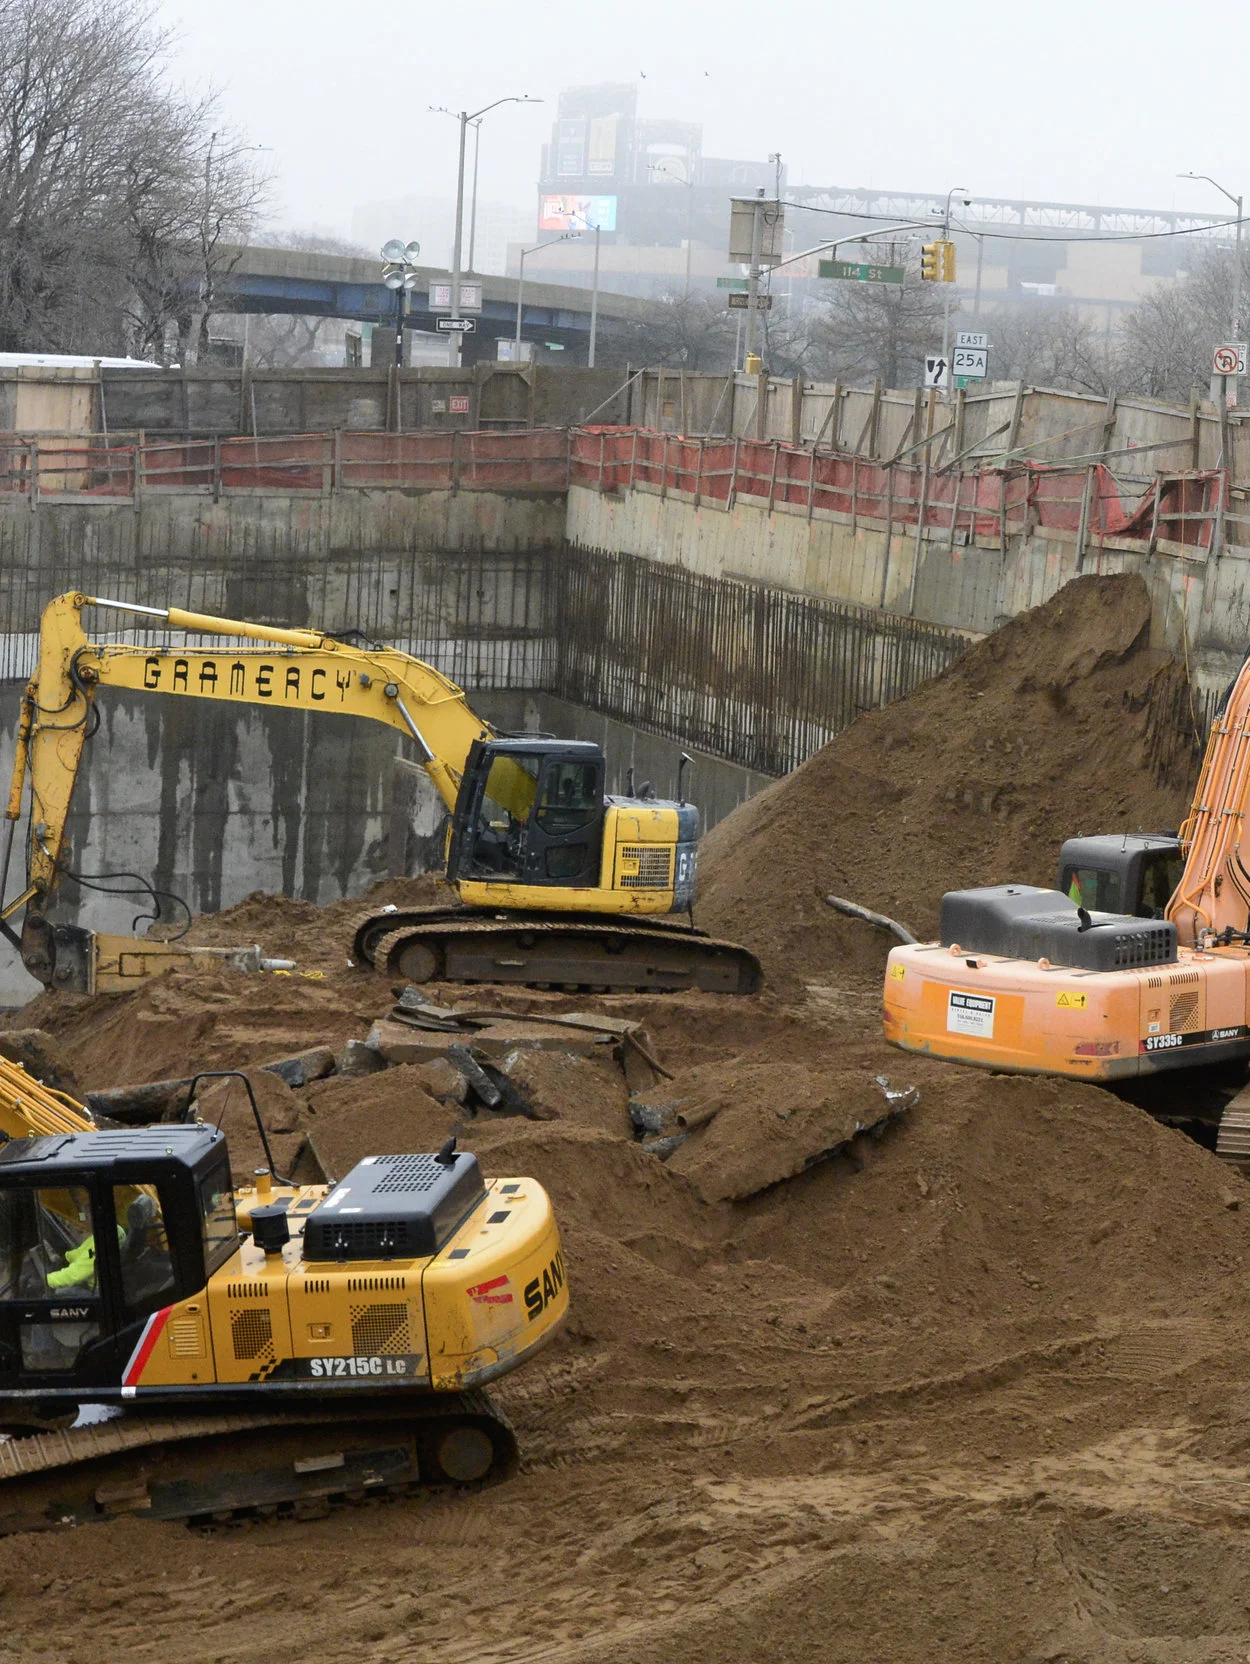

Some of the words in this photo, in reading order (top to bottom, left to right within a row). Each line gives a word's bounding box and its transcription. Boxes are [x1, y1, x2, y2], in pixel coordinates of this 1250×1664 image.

[842, 266, 861, 278] 114
[868, 268, 883, 280] St
[960, 334, 983, 345] EAST
[956, 353, 984, 368] 25A
[451, 399, 467, 410] EXIT
[143, 656, 351, 702] GRAMERCY
[1219, 1028, 1239, 1038] SANY
[524, 1250, 565, 1322] SAN
[50, 1307, 89, 1318] SANY
[310, 1356, 382, 1377] SY215C
[386, 1359, 407, 1375] LC
